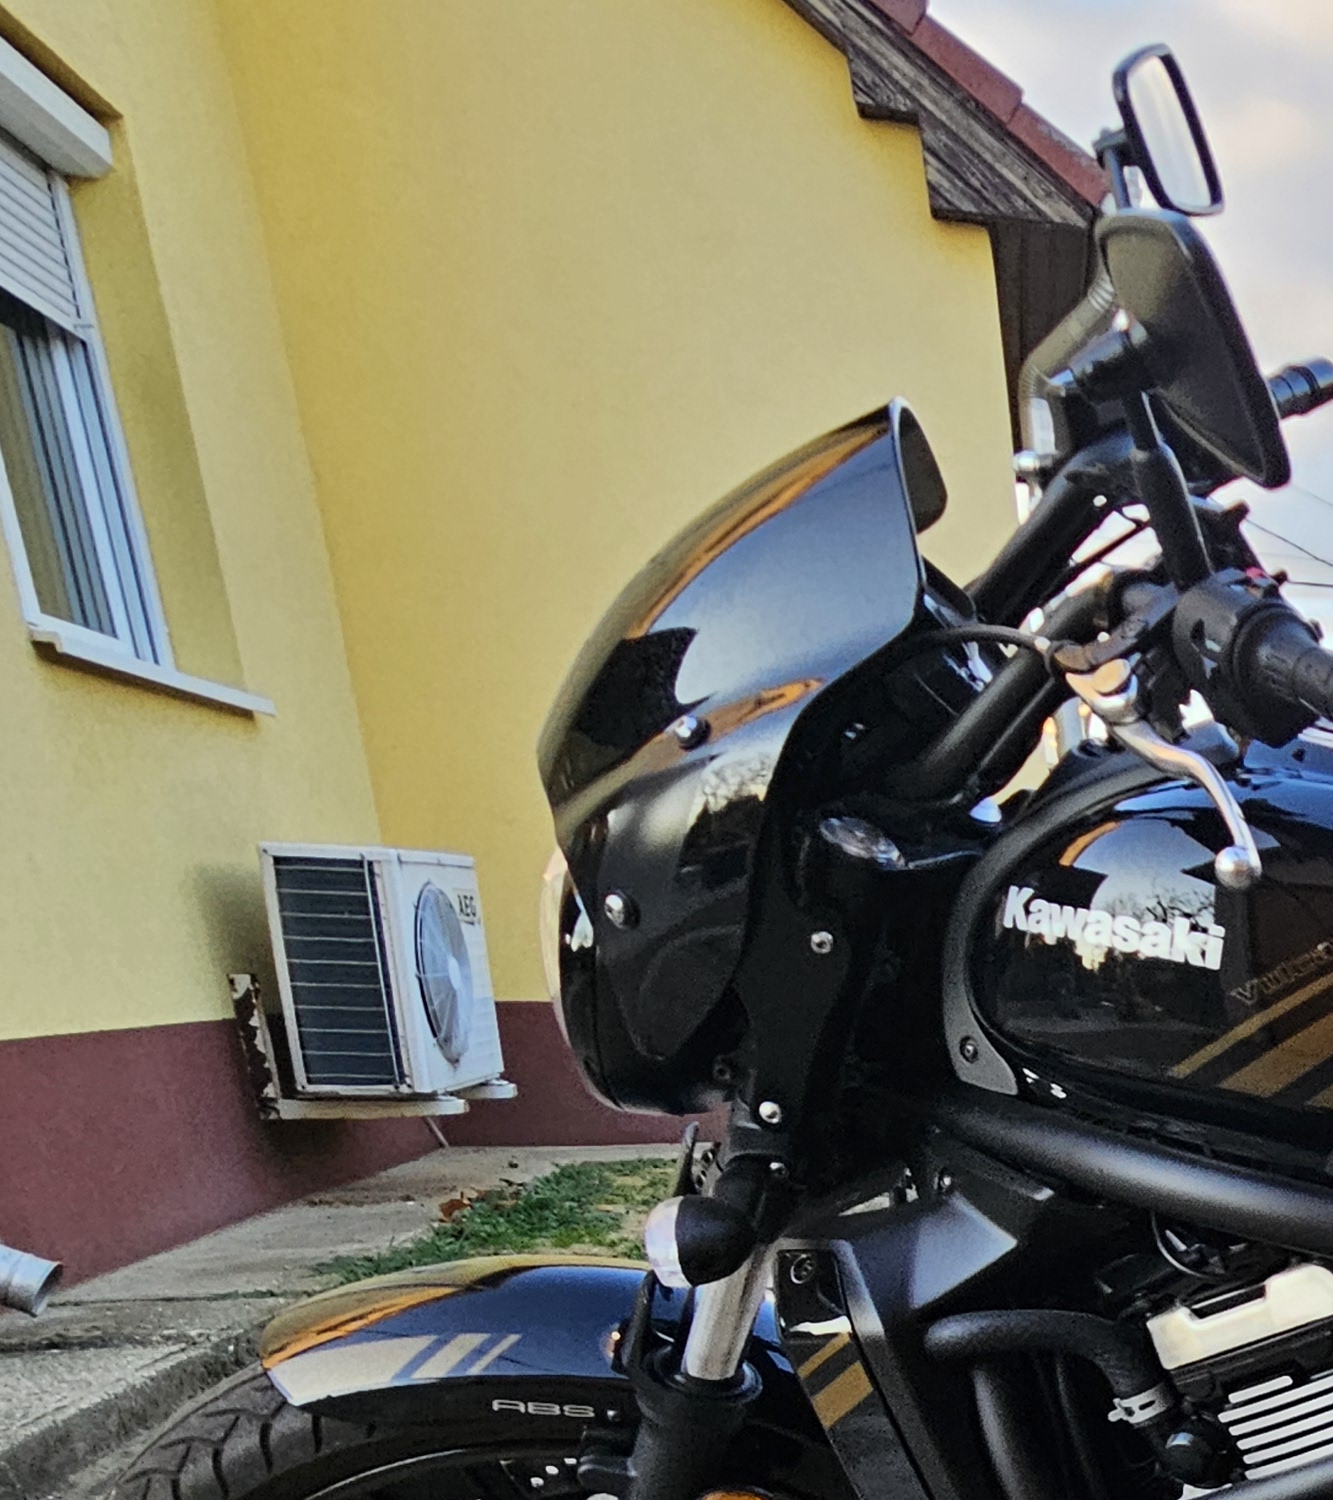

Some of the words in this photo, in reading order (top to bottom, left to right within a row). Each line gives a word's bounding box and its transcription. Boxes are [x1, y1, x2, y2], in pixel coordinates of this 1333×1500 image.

[457, 893, 477, 917] AEG
[1003, 885, 1226, 970] Kawasaki
[492, 1399, 595, 1418] ABS
